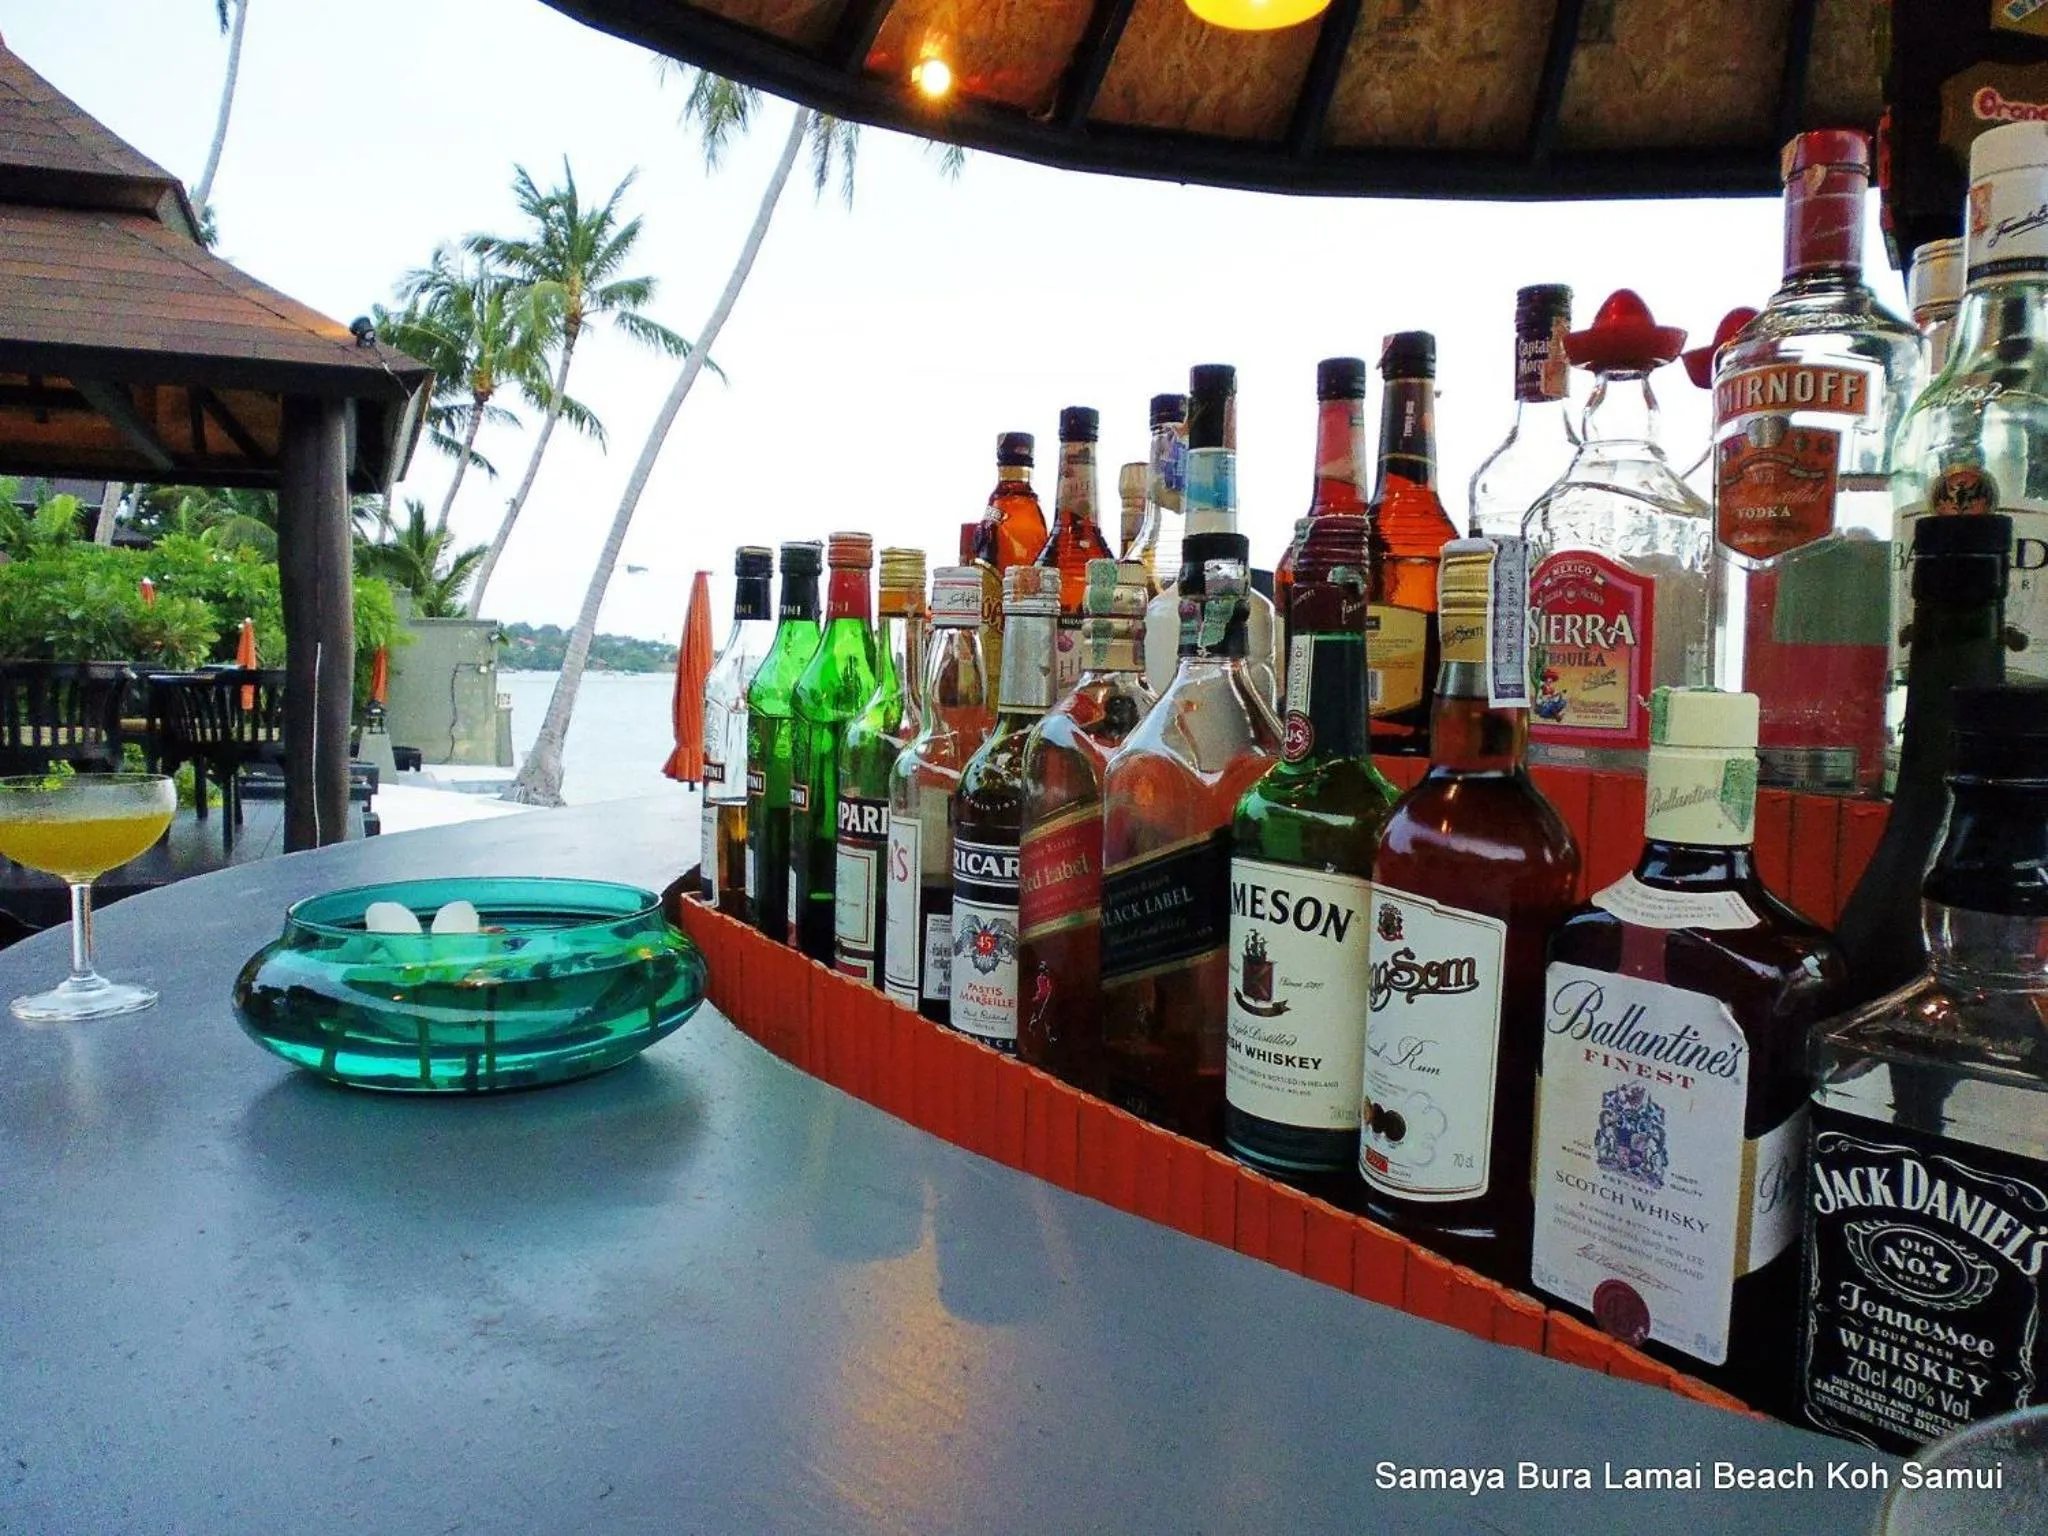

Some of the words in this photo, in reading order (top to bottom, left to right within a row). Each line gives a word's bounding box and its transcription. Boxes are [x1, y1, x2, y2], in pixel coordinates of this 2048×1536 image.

[1719, 371, 1861, 413] MIRNOFF
[1552, 564, 1593, 576] MEXICO
[953, 849, 1019, 880] RICAR
[1044, 852, 1090, 886] Label
[1144, 886, 1195, 914] LABEL
[1231, 880, 1354, 943] MESON
[959, 992, 1015, 1009] MARSEILLE
[967, 982, 1003, 997] PASTIS
[1547, 979, 1740, 1079] Ballantine's
[1245, 1044, 1322, 1071] WHISKEY
[1583, 1047, 1696, 1090] FINEST
[1555, 1169, 1625, 1206] SCOTCH
[1631, 1197, 1711, 1235] WHISKY
[1813, 1162, 1896, 1215] JACK
[1902, 1158, 2048, 1277] DANIEL'S
[1899, 1237, 1935, 1257] Old
[1838, 1281, 1995, 1358] Tennessee
[1838, 1327, 1991, 1398] WHISKEY
[1847, 1355, 1887, 1389] 70cl
[1891, 1375, 1936, 1408] 40%
[1813, 1378, 1850, 1401] JACK
[1852, 1393, 1911, 1425] DANIEL
[1889, 1398, 1915, 1414] AND
